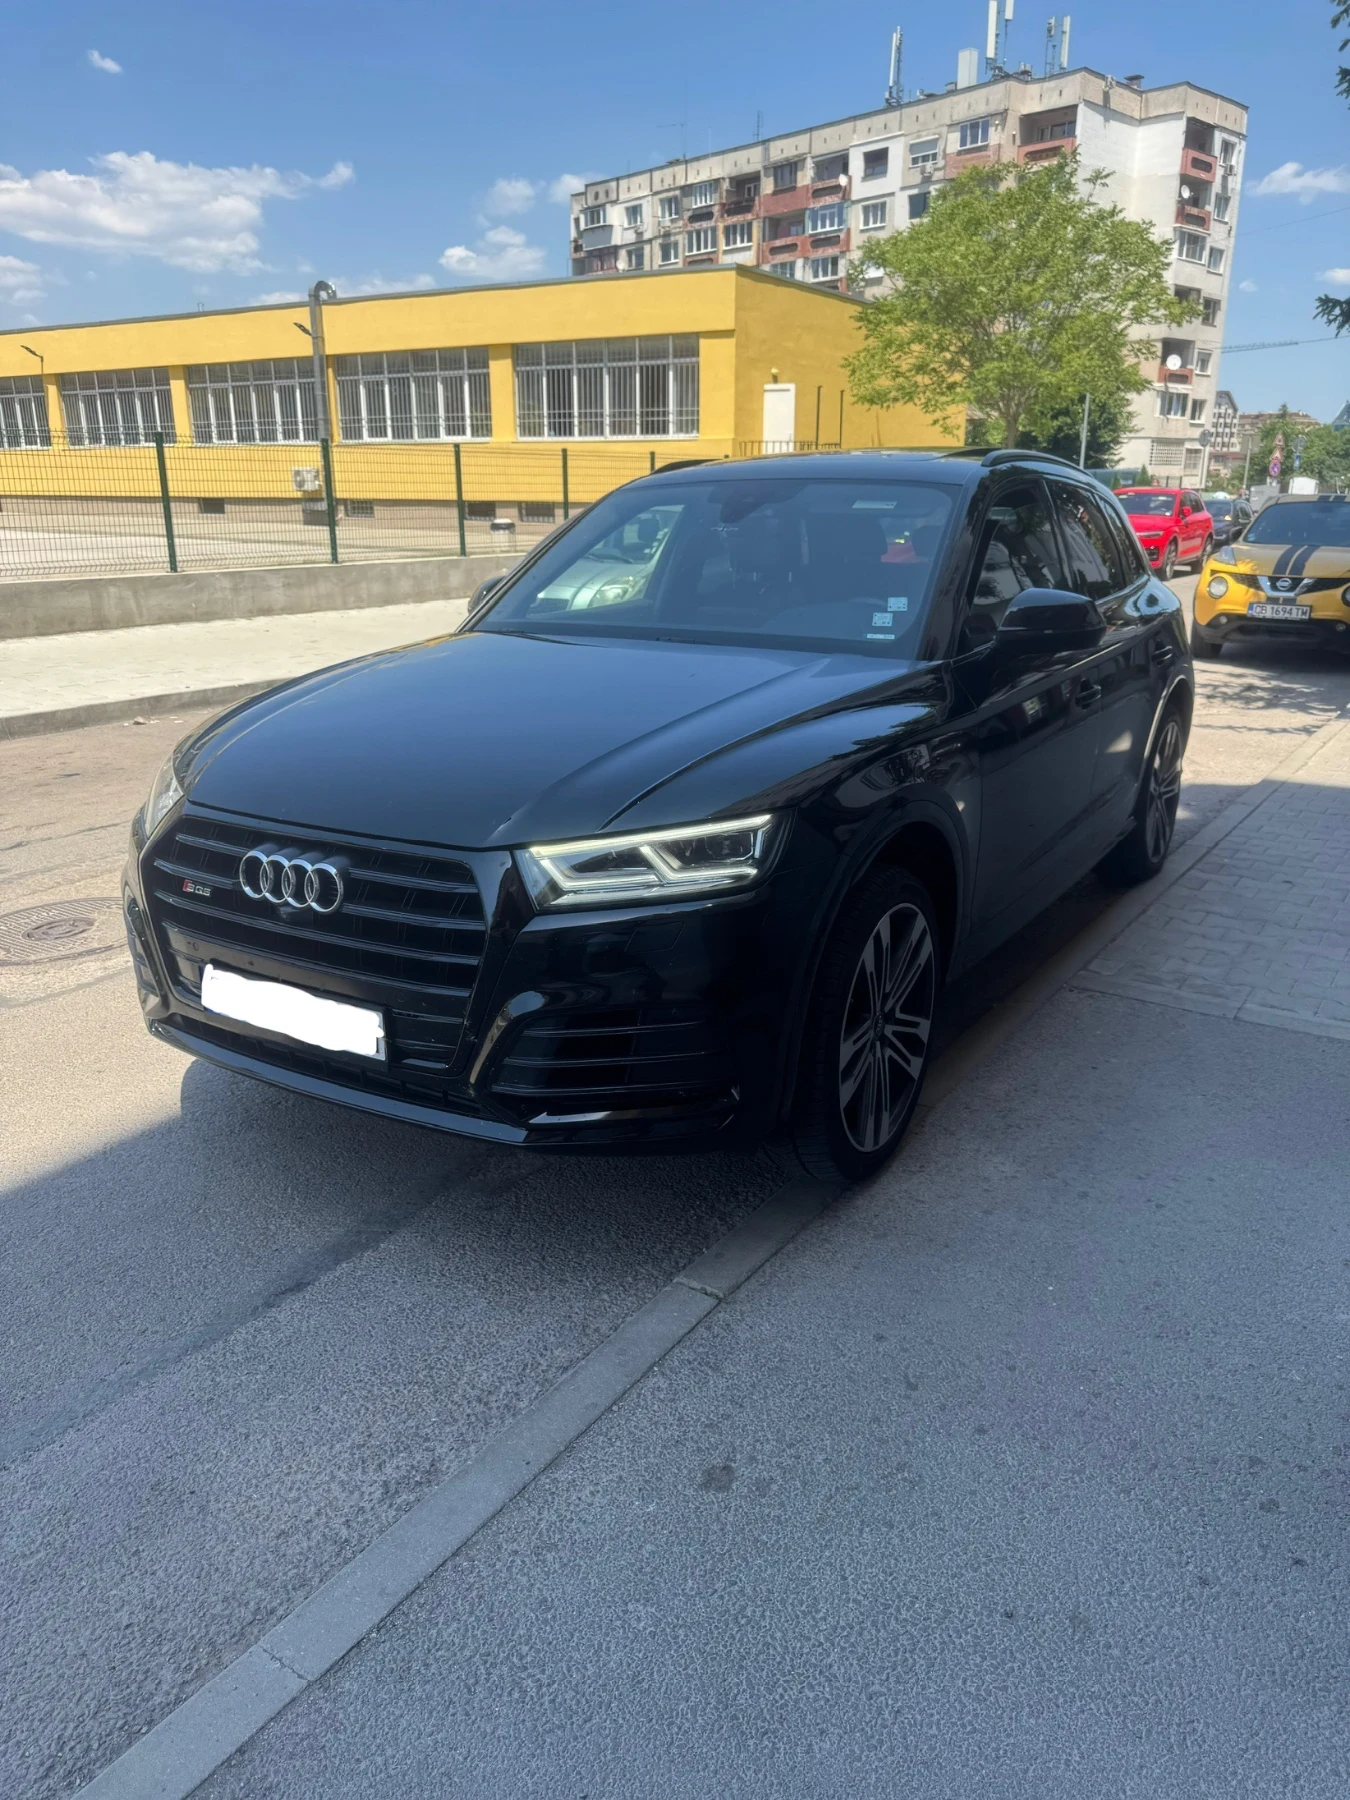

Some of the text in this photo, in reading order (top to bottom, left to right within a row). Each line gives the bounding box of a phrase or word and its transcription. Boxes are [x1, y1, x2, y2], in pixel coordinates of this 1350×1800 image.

[1254, 605, 1308, 617] CB 1694 TM
[183, 879, 211, 896] SQ5
